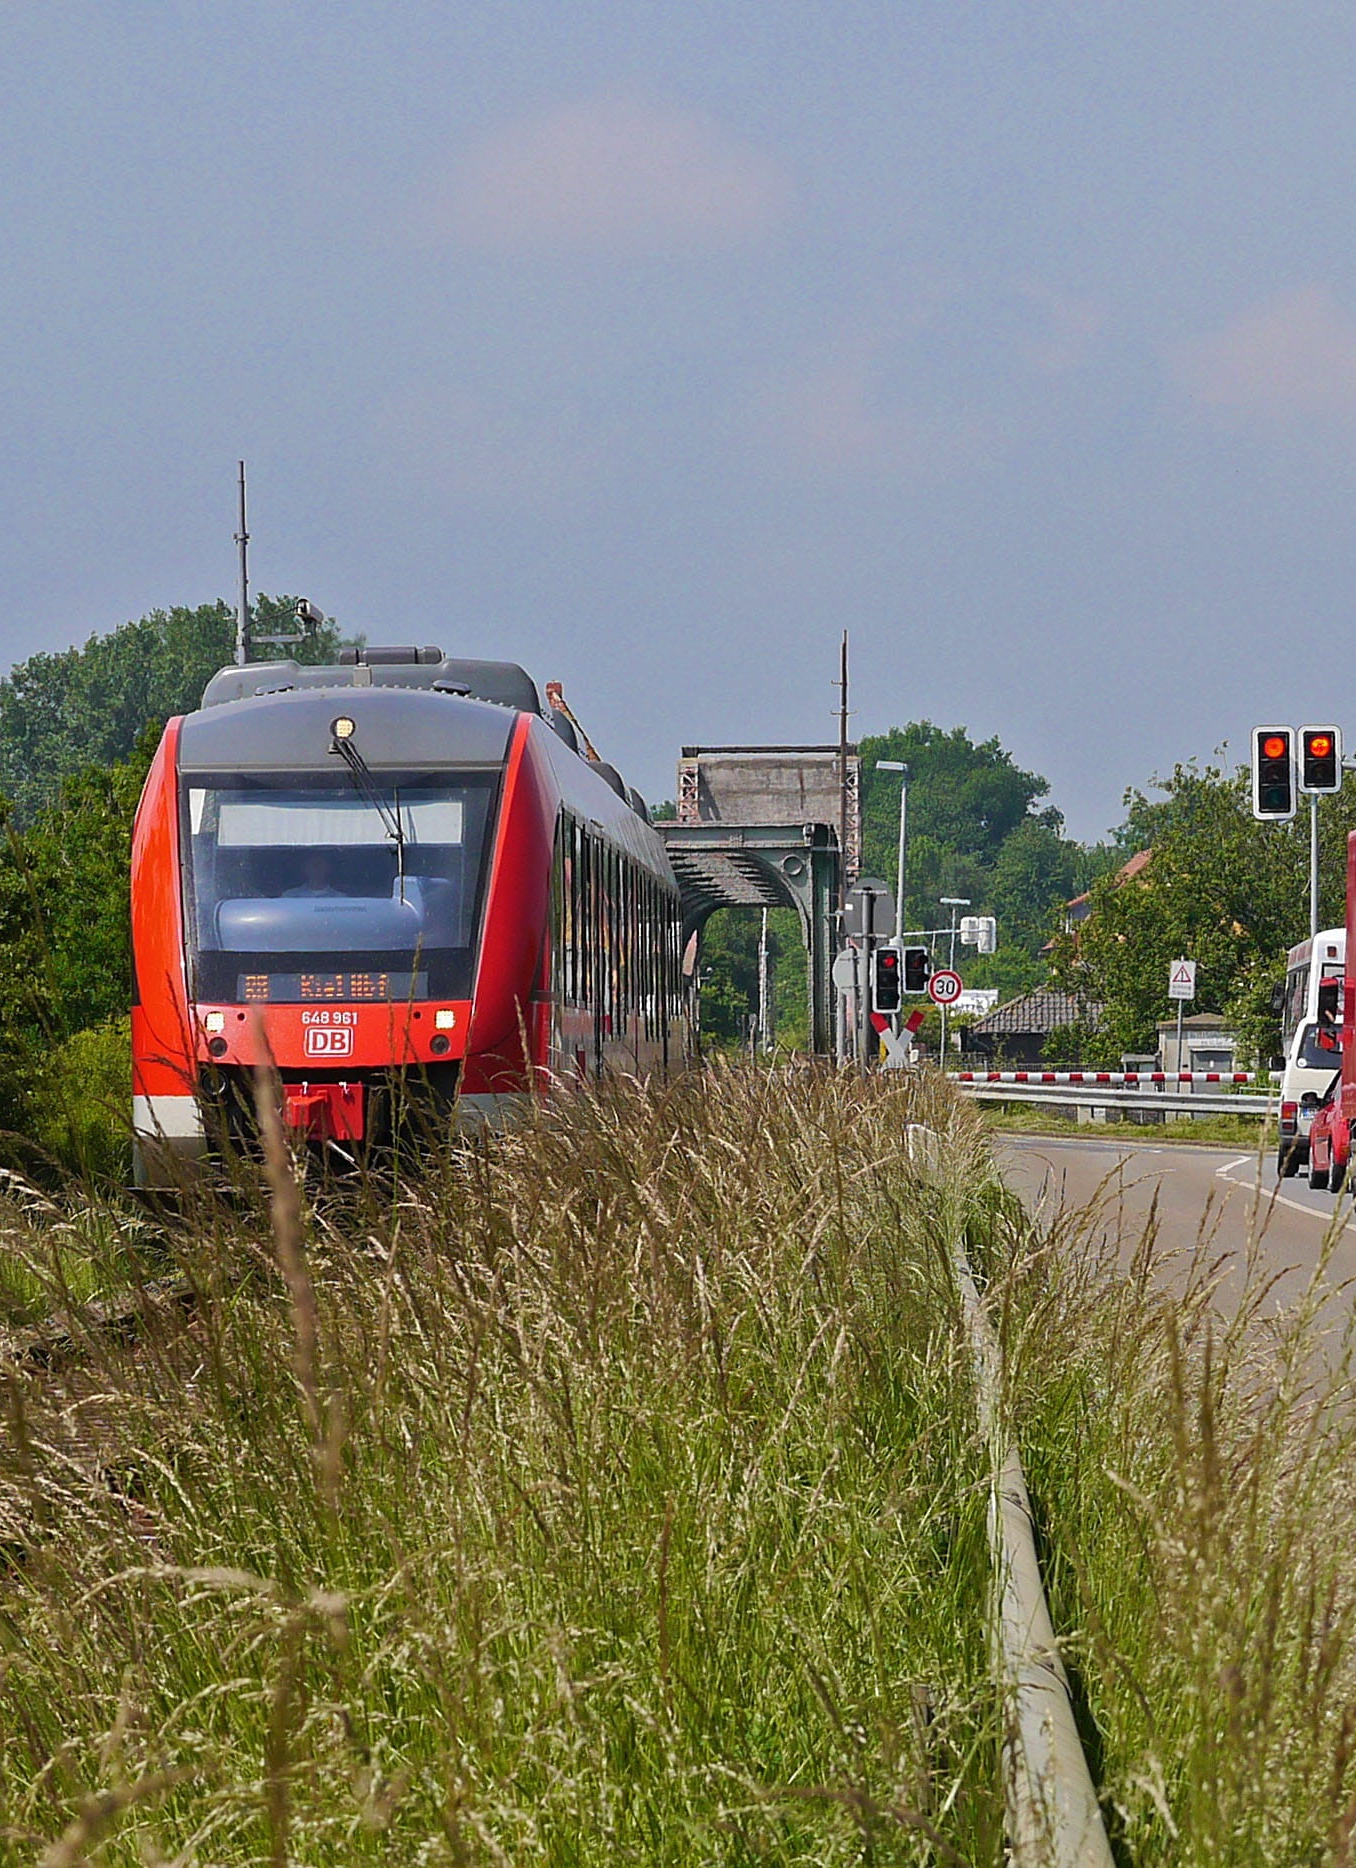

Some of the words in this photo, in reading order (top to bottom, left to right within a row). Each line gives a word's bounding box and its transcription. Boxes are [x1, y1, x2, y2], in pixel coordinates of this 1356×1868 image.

[301, 974, 344, 997] Kiel
[935, 979, 956, 995] 30
[302, 1011, 330, 1024] 648
[332, 1011, 358, 1025] 961
[312, 1031, 346, 1051] DB
